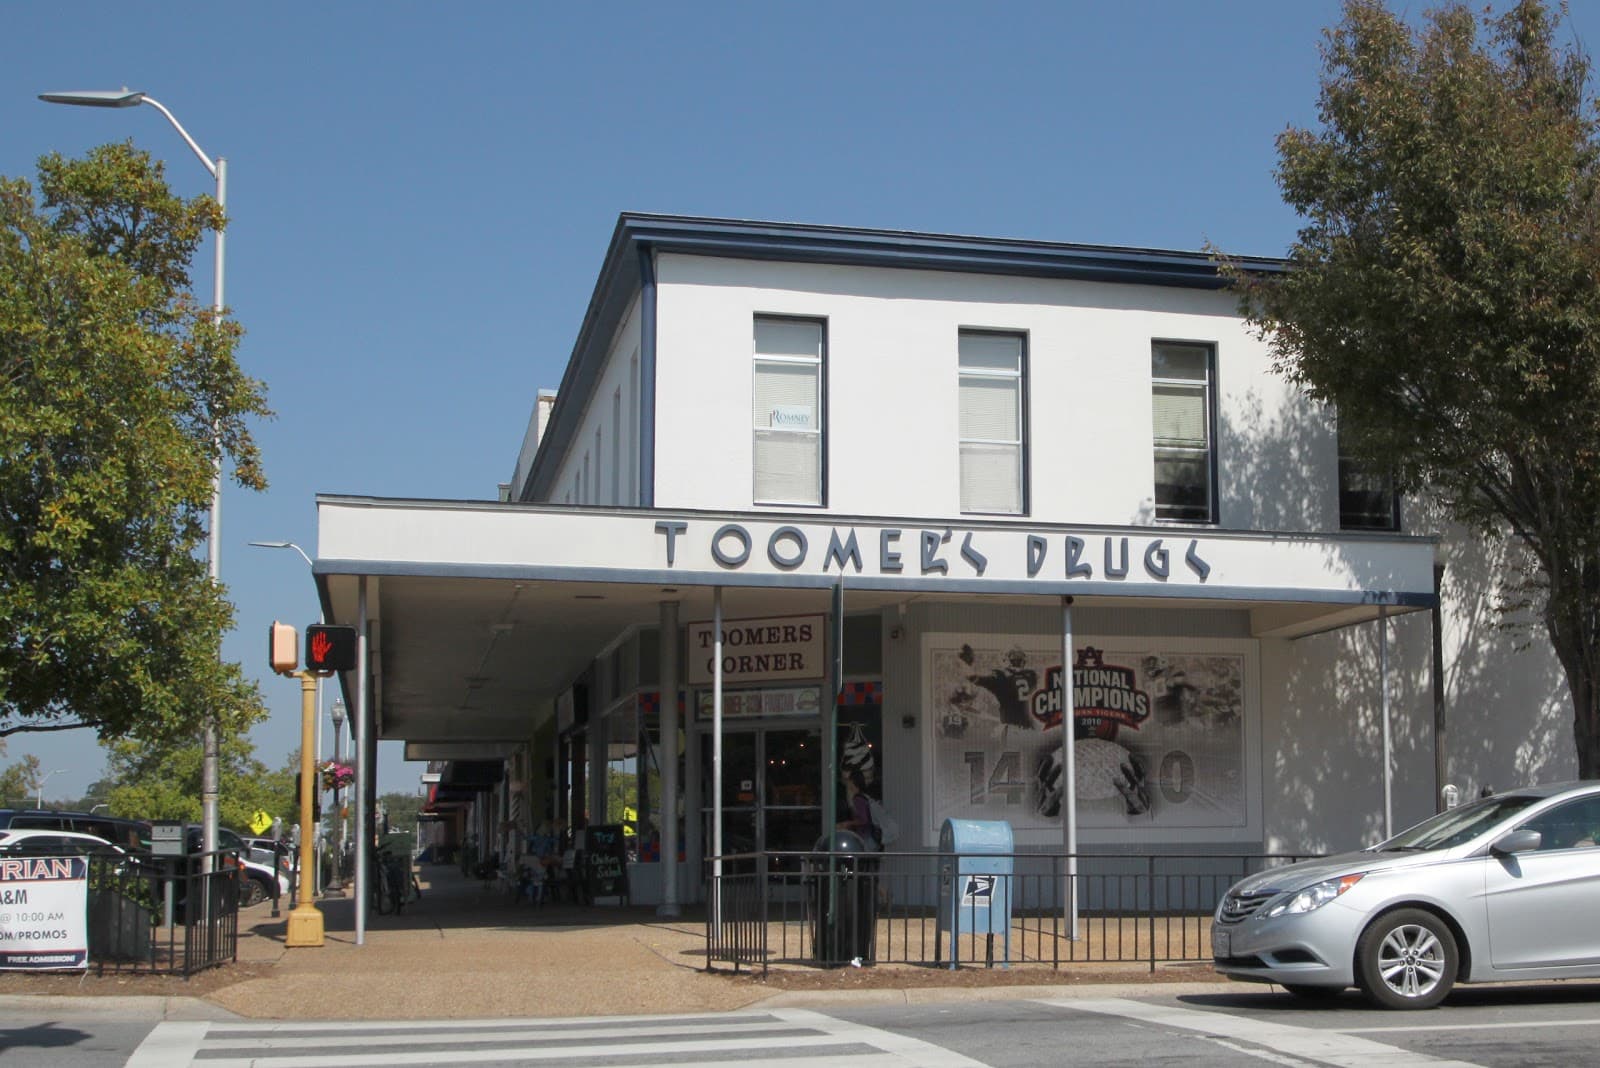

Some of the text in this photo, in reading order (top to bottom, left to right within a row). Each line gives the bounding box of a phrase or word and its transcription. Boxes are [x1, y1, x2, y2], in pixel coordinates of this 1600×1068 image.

[654, 521, 1211, 582] TOOMER'S DRUGS
[1052, 669, 1130, 690] NTIONAL
[1035, 687, 1147, 716] CHMPIONS
[0, 859, 73, 880] RIAN
[16, 912, 44, 922] 10:00
[47, 912, 65, 921] AM
